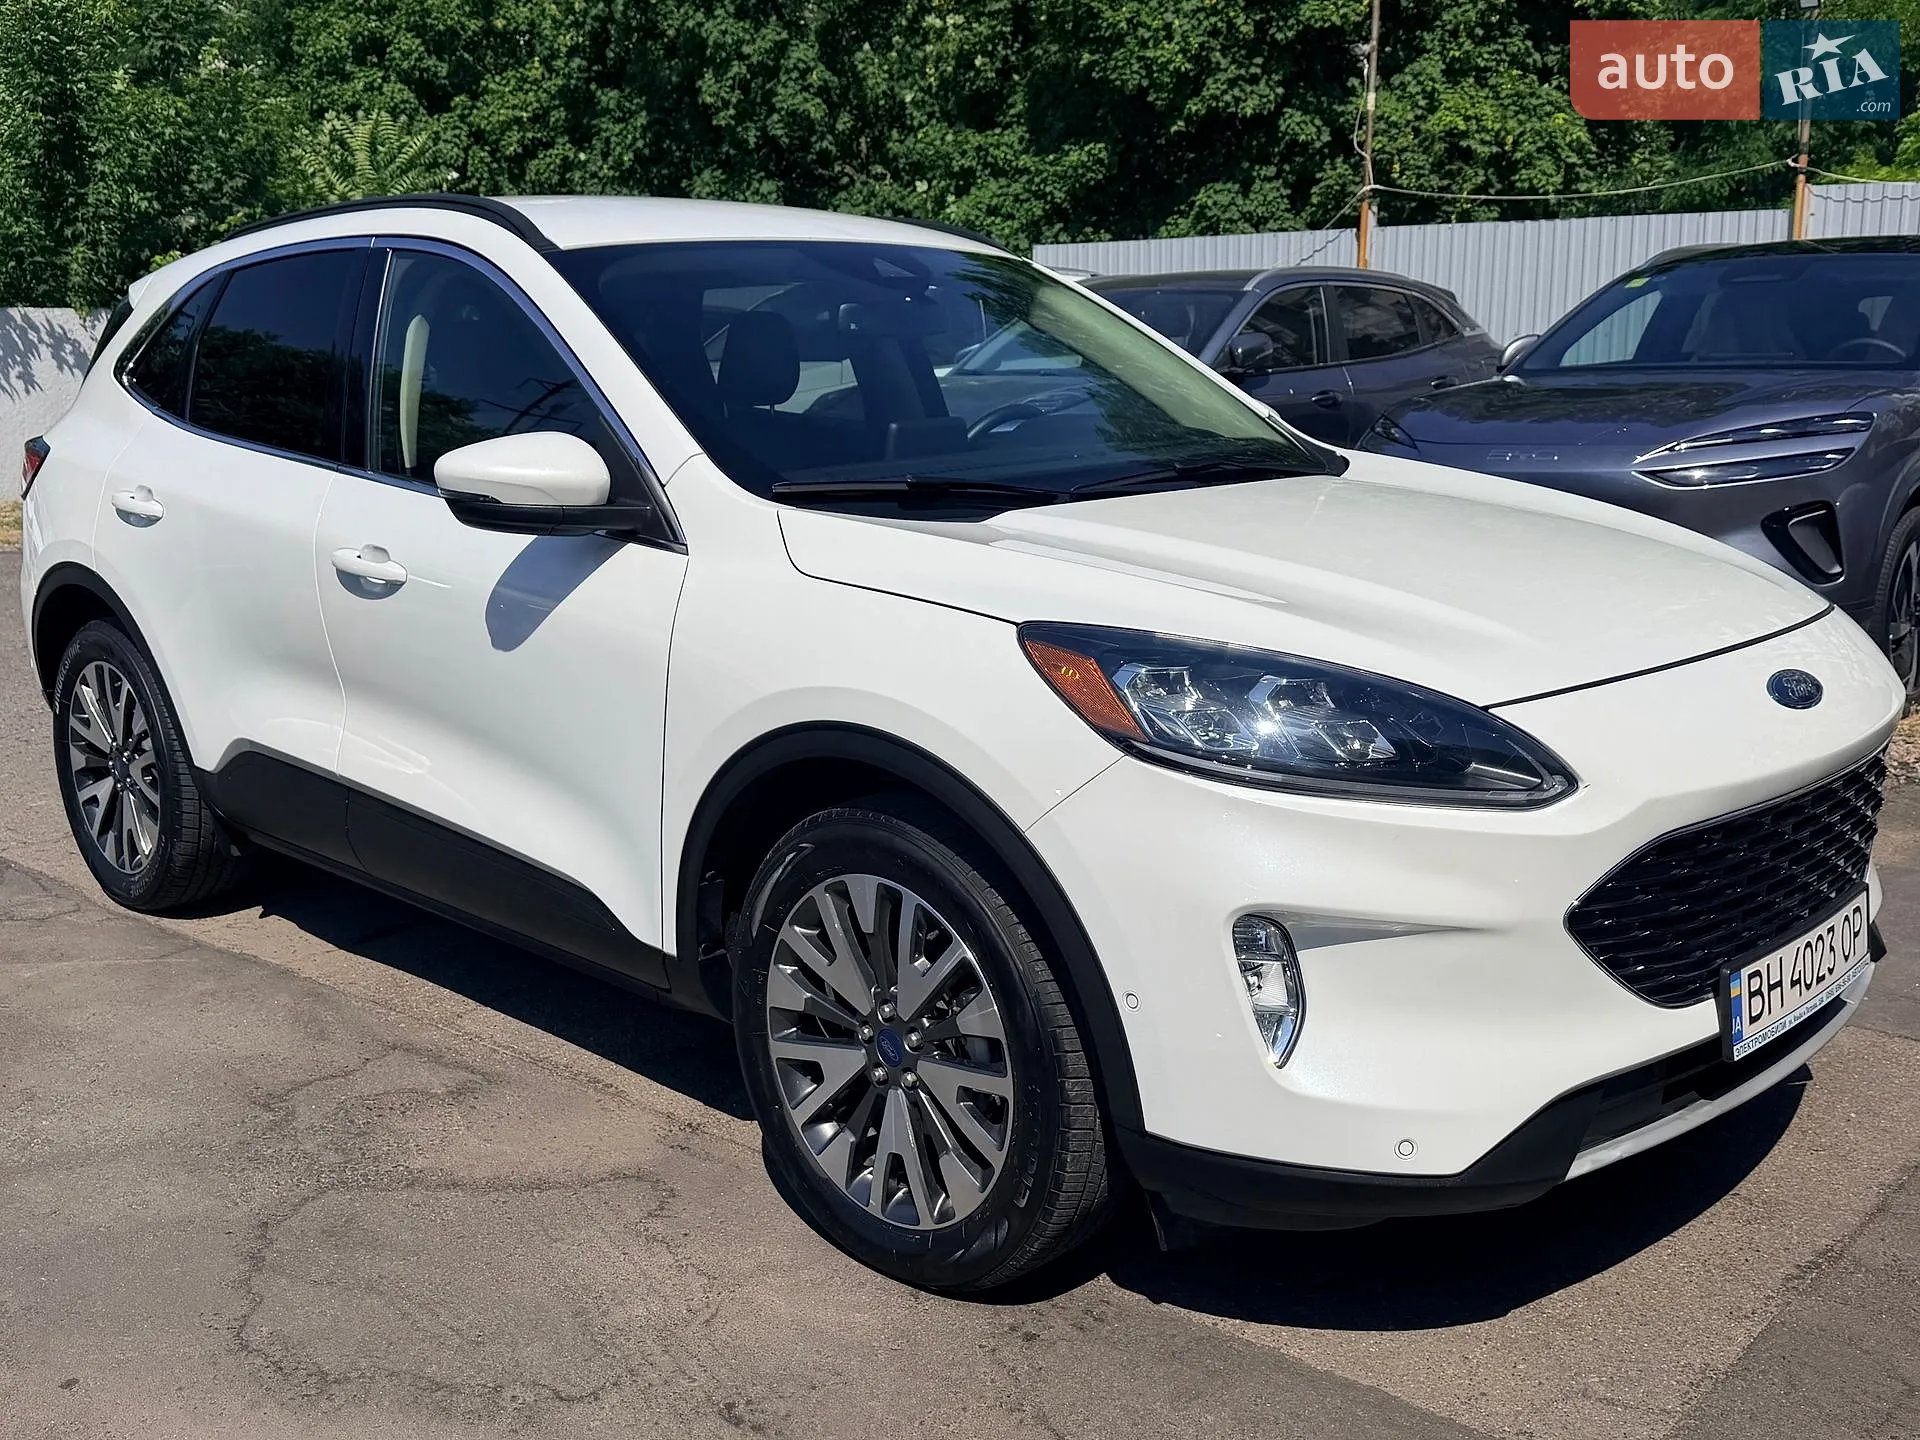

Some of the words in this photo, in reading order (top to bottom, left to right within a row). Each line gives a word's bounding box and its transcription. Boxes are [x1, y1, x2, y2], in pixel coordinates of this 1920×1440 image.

[1747, 954, 1784, 1025] BH
[1790, 923, 1836, 997] 4023
[1841, 905, 1863, 962] OP
[1735, 1020, 1787, 1058] ЭЛЕКТРОМОБИЛИ
